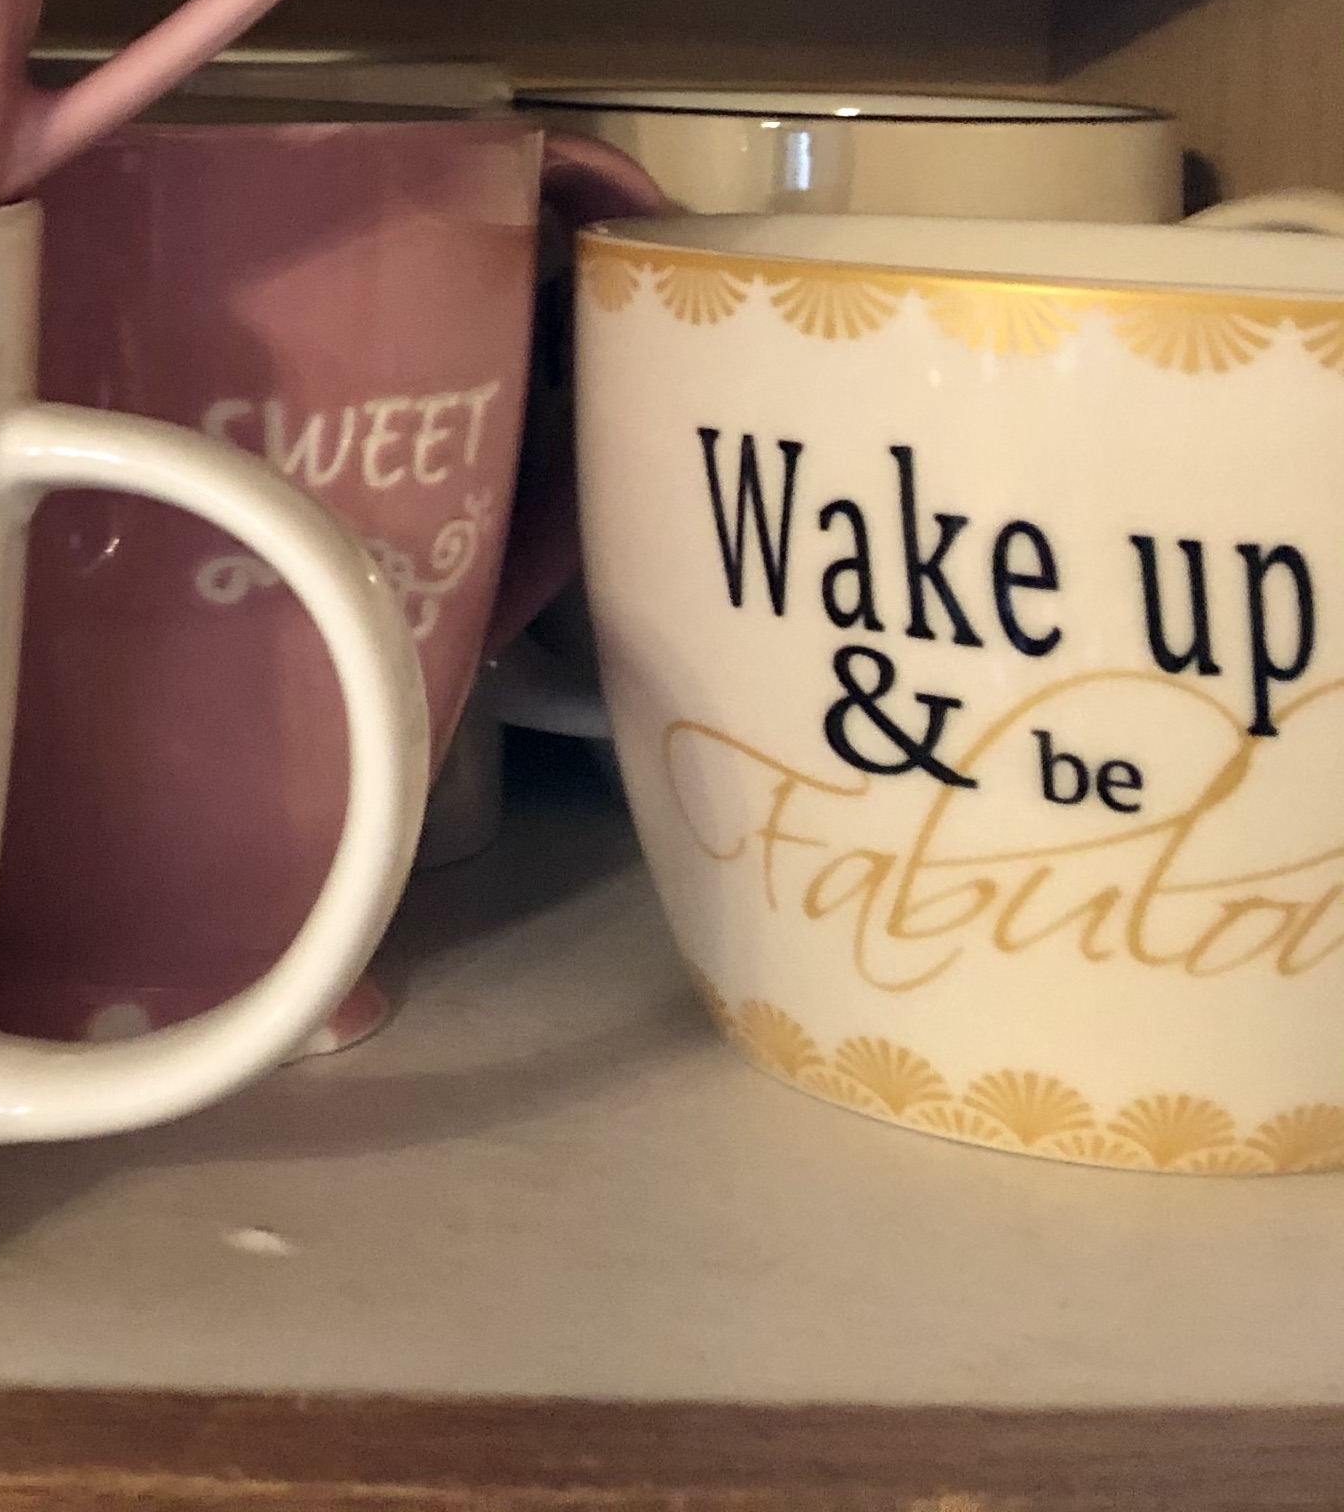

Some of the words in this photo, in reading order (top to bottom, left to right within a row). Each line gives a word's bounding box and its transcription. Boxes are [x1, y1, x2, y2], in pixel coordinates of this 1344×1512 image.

[696, 426, 1064, 657] Wake
[1128, 533, 1316, 738] up
[823, 644, 979, 789] &
[1031, 729, 1145, 814] be
